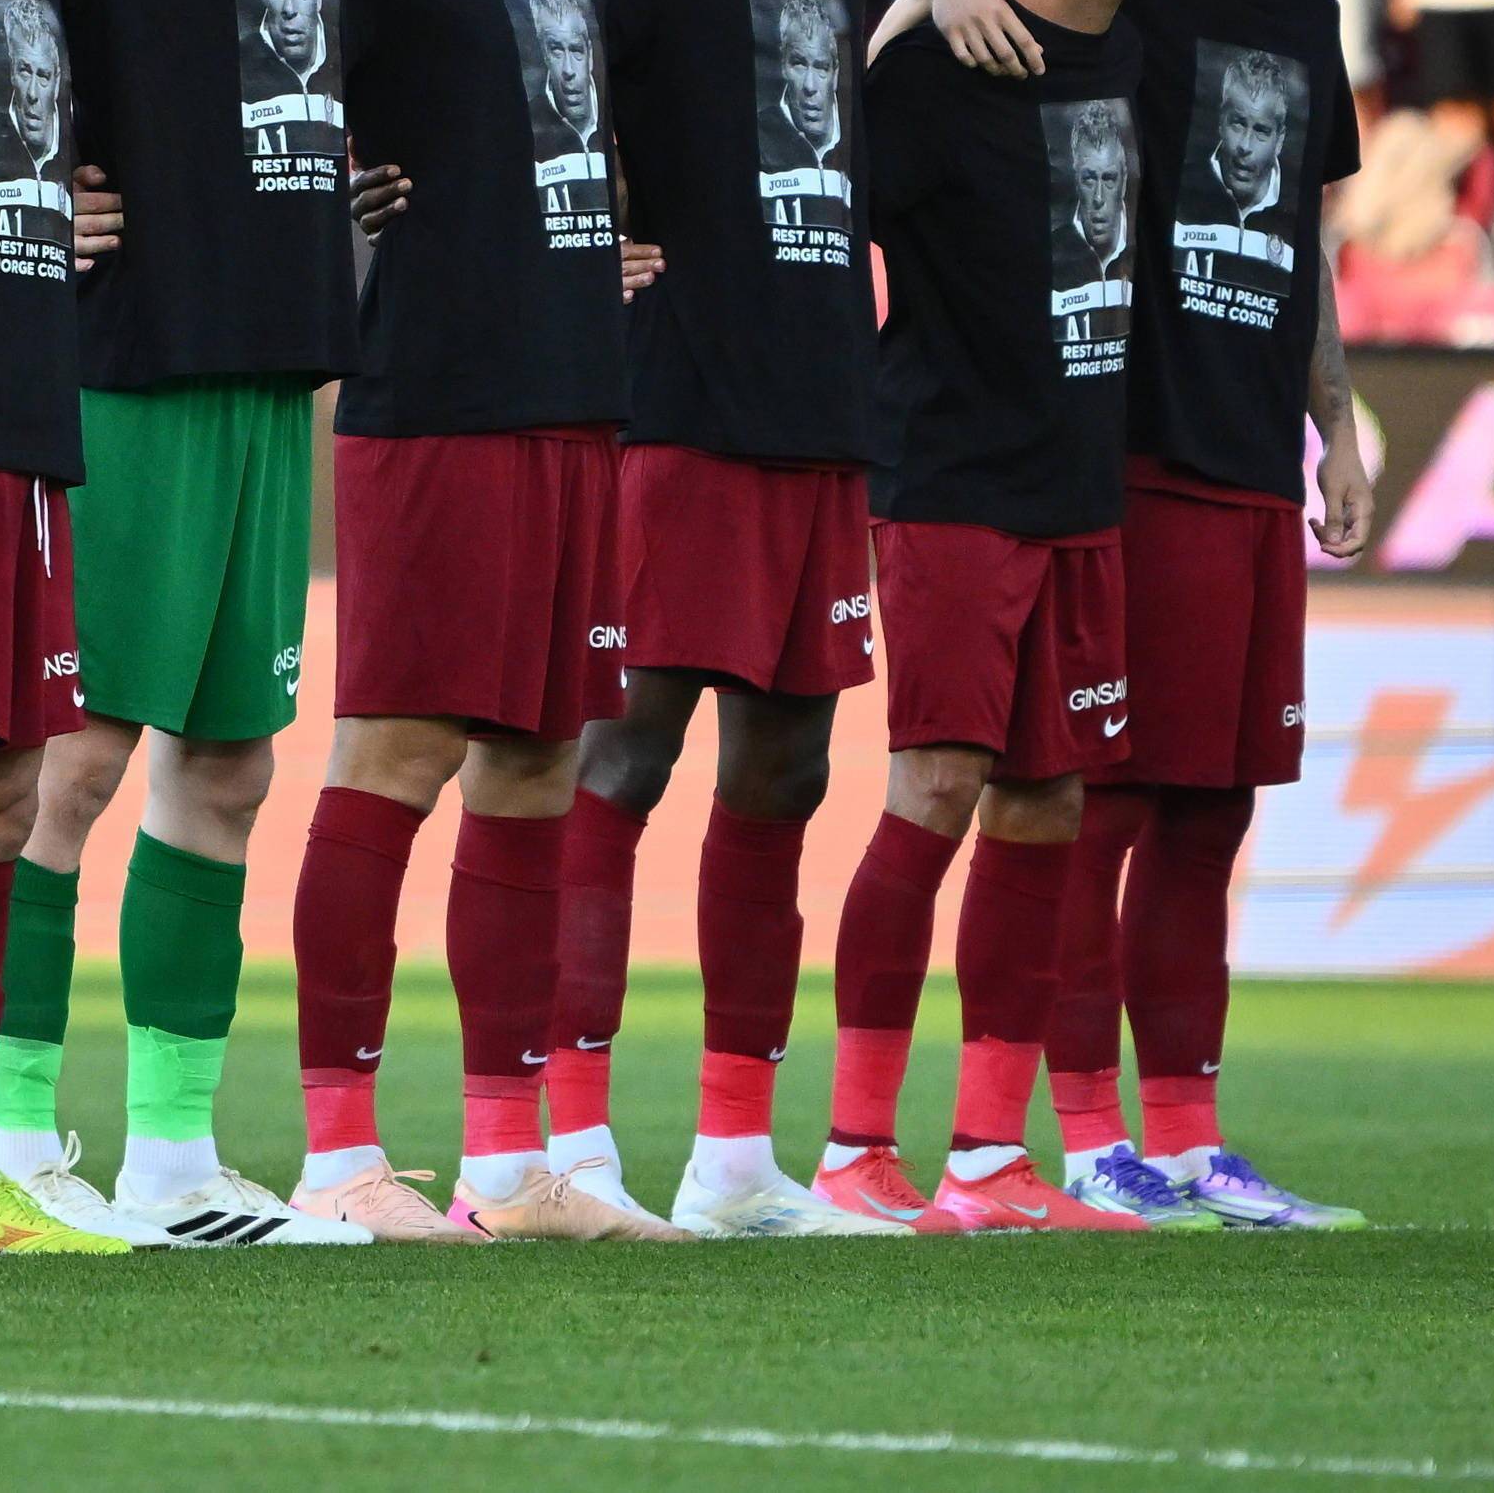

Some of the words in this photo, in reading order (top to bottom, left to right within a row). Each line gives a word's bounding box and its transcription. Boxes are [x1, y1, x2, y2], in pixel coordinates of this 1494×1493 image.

[252, 158, 292, 173] REST
[295, 157, 313, 172] IN
[255, 176, 310, 191] JORGE
[545, 215, 575, 231] REST
[577, 215, 593, 229] IN
[549, 233, 591, 249] JORGE
[772, 228, 805, 244] REST
[809, 230, 824, 244] IN
[25, 243, 39, 258] IN
[775, 246, 821, 262] JORGE
[1180, 277, 1214, 297] REST
[1216, 285, 1233, 301] IN
[1236, 290, 1279, 315] PEACE,
[1182, 295, 1226, 317] JORGE
[1229, 306, 1274, 329] COSTA!
[1062, 344, 1093, 359] REST
[1065, 360, 1102, 377] JORGE
